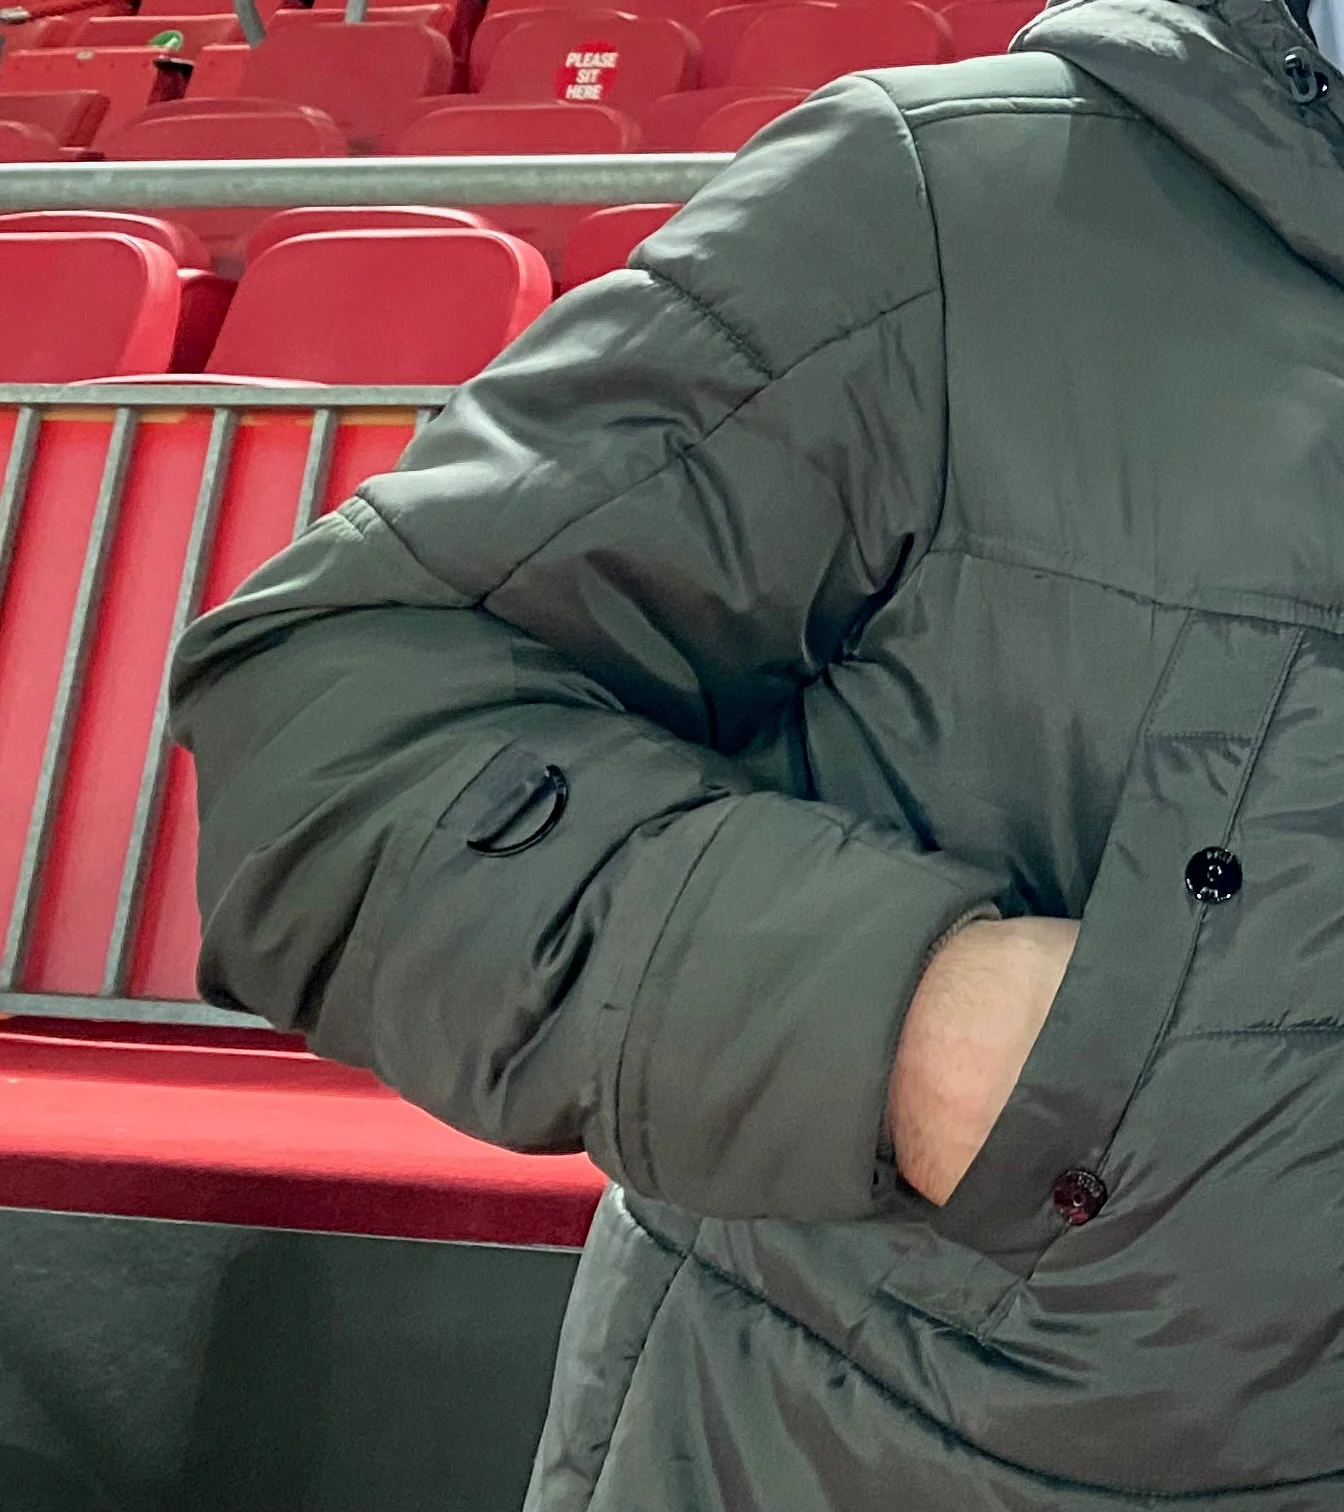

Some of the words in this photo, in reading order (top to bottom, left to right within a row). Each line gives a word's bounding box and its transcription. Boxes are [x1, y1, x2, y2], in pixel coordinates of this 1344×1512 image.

[565, 52, 619, 68] PLEASE
[575, 68, 602, 84] SIT
[565, 84, 603, 100] HERE
